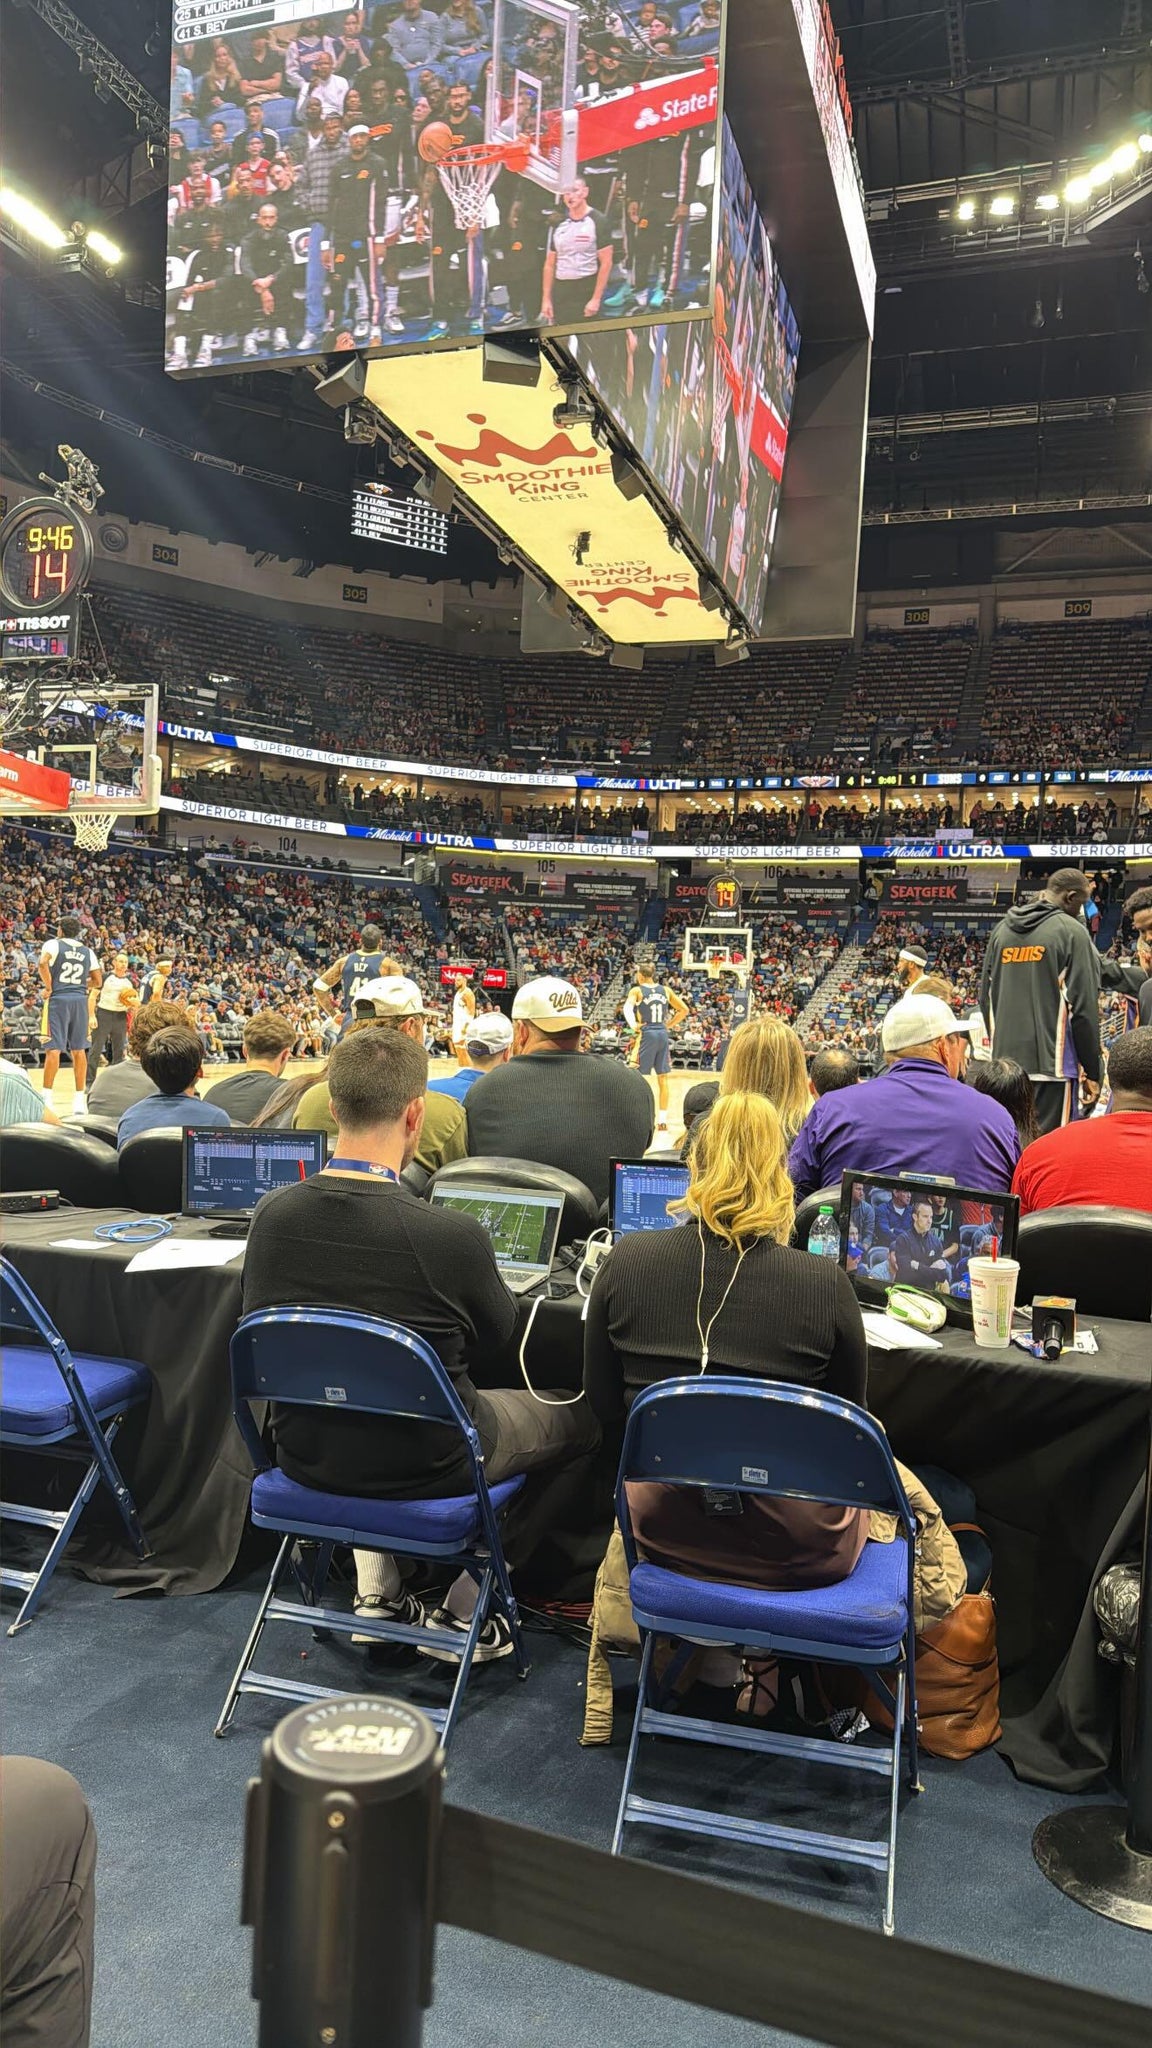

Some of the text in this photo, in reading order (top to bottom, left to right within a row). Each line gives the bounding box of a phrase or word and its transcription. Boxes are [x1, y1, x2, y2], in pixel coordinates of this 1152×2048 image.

[178, 9, 191, 20] 25
[204, 0, 249, 16] MURPHY
[178, 28, 190, 39] 41
[206, 20, 228, 34] BEY
[460, 463, 612, 485] SMOOTHIE
[518, 492, 589, 503] CENTER
[28, 526, 74, 552] 9:46
[154, 548, 177, 562] 304
[33, 553, 68, 598] 14
[565, 572, 692, 587] SMOOTHIE
[344, 588, 366, 600] 305
[1066, 603, 1091, 614] 309
[18, 615, 70, 630] TISSOT
[904, 611, 929, 622] 308
[167, 722, 214, 744] ULTRA
[253, 740, 388, 769] SUPERIOR LIGHT BEER
[427, 765, 559, 785] SUPERIOR LIGHT BEER
[595, 777, 636, 788] Michelob
[847, 776, 854, 786] 4
[1111, 770, 1152, 782] Michelo
[182, 801, 327, 832] SUPERIOR LIGHT BEER
[278, 836, 297, 852] 104
[366, 827, 475, 848] Michelob ULTRA
[512, 840, 654, 856] SUPERIOR LIGHT BEER
[695, 846, 841, 856] SUPERIOR LIGHT BEER
[883, 845, 1004, 858] Michelob ULTRA
[1050, 845, 1126, 856] SUPERIOR
[537, 860, 556, 873] 105
[763, 866, 784, 878] 106
[947, 865, 968, 878] 107
[451, 872, 512, 890] SEATGEEK
[720, 891, 734, 907] 14
[890, 885, 958, 900] SEATGEEK
[59, 962, 84, 984] 22
[549, 990, 578, 1008] Wild
[650, 1004, 662, 1022] 11
